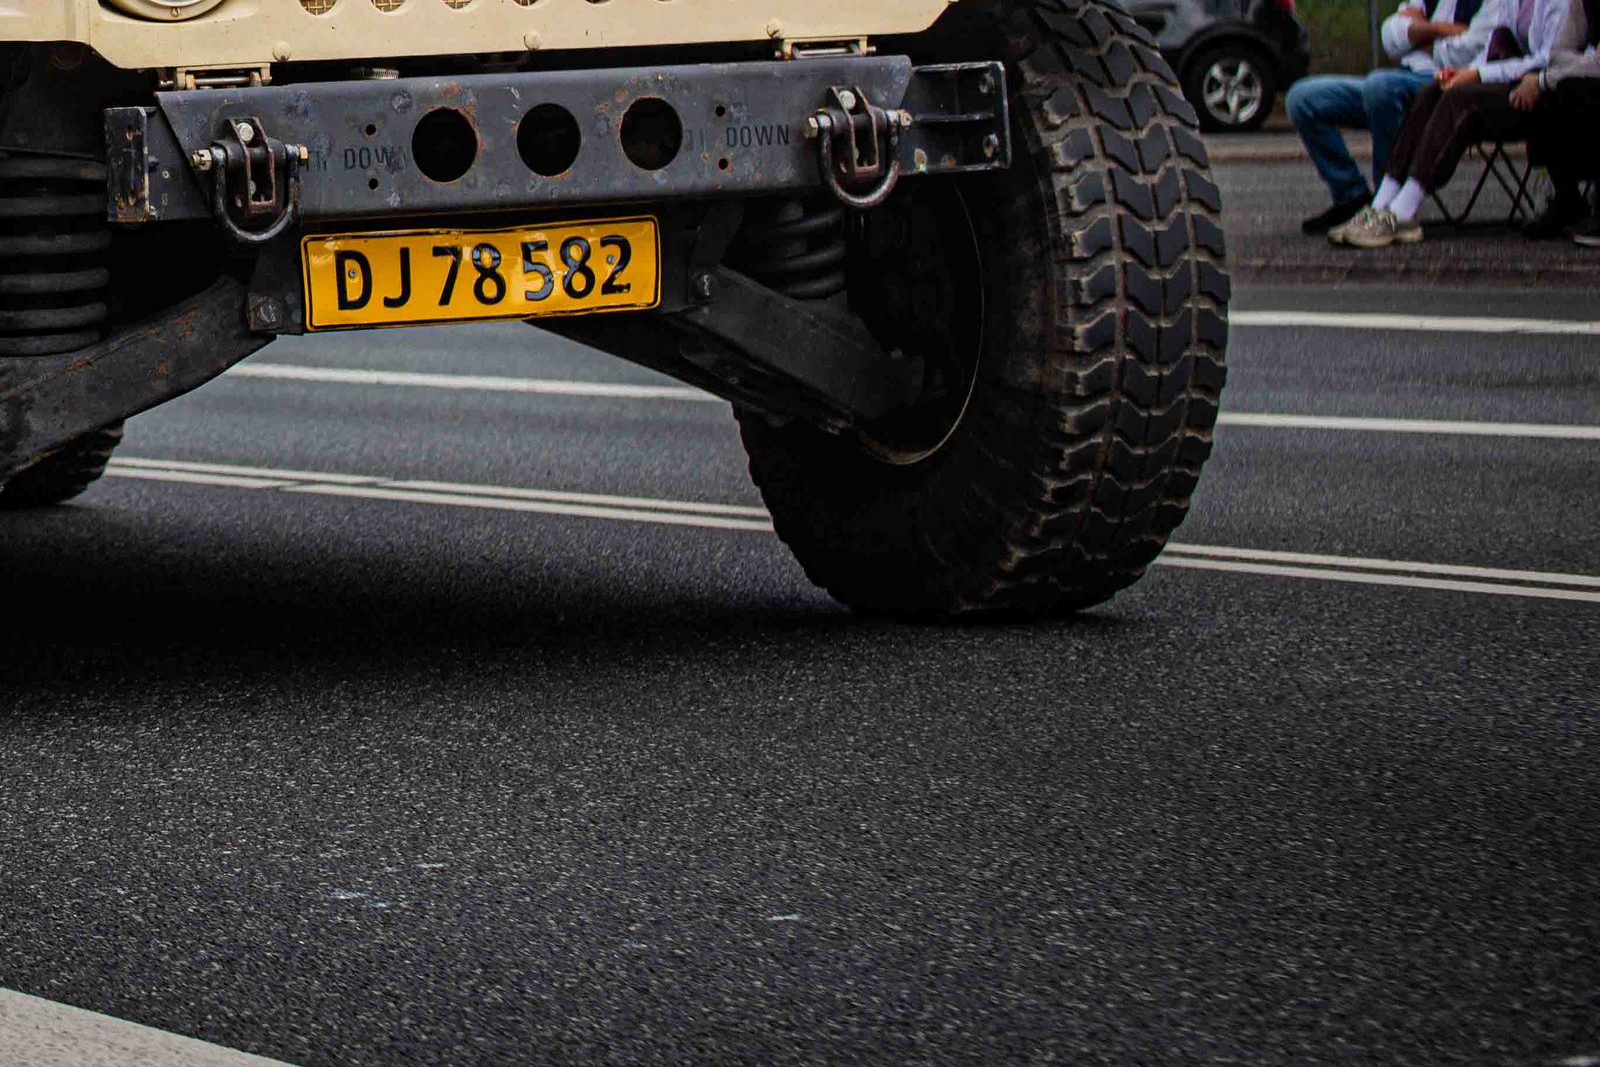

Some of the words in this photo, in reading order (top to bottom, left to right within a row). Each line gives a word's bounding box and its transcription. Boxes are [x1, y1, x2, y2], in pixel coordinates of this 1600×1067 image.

[726, 124, 789, 148] DOWN
[334, 246, 410, 311] DJ
[432, 242, 506, 306] 78
[520, 235, 632, 301] 582
